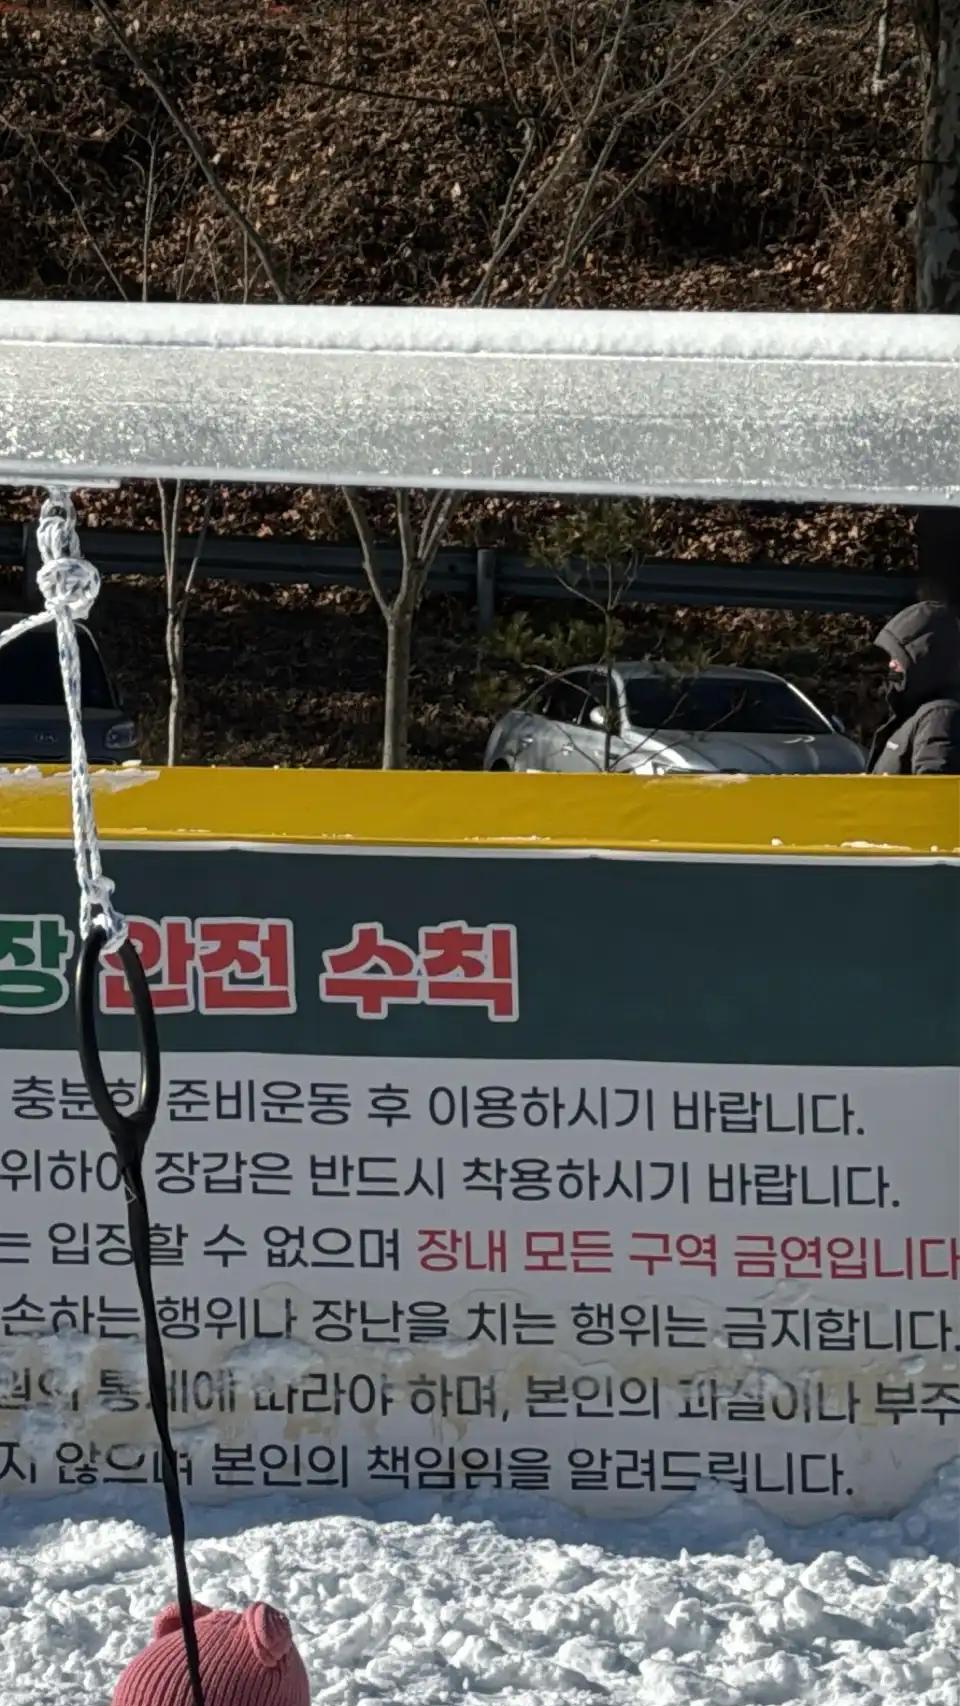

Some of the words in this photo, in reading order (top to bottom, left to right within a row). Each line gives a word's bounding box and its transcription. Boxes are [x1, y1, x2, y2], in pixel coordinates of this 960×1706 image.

[98, 914, 299, 1016] 안전
[319, 919, 520, 1022] 수칙
[166, 1079, 352, 1125] 준비운동
[367, 1082, 412, 1129] 후
[428, 1084, 655, 1132] 이용하시기
[672, 1089, 866, 1137] 바랍니다.
[154, 1151, 294, 1196] 장갑은
[309, 1153, 445, 1200] 반드시
[462, 1157, 690, 1205] 착용하시기
[707, 1162, 901, 1209] 바랍니다.
[47, 1222, 189, 1267] 입장할
[202, 1223, 248, 1269] 수
[263, 1225, 400, 1271] 없으며
[417, 1228, 507, 1274] 장내
[523, 1230, 614, 1274] 모든
[628, 1231, 718, 1277] 구역
[733, 1234, 960, 1281] 금연입니다
[155, 1295, 298, 1340] 행위나
[311, 1299, 451, 1344] 장난을
[466, 1301, 558, 1348] 치는
[570, 1302, 709, 1349] 행위는
[723, 1306, 960, 1352] 금지합니다.
[406, 1373, 510, 1423] 하며,
[525, 1374, 661, 1420] 본인의
[874, 1380, 960, 1427] 부주
[211, 1442, 349, 1489] 본인의
[366, 1444, 552, 1491] 책임임을
[567, 1447, 855, 1496] 알려드립니다.
